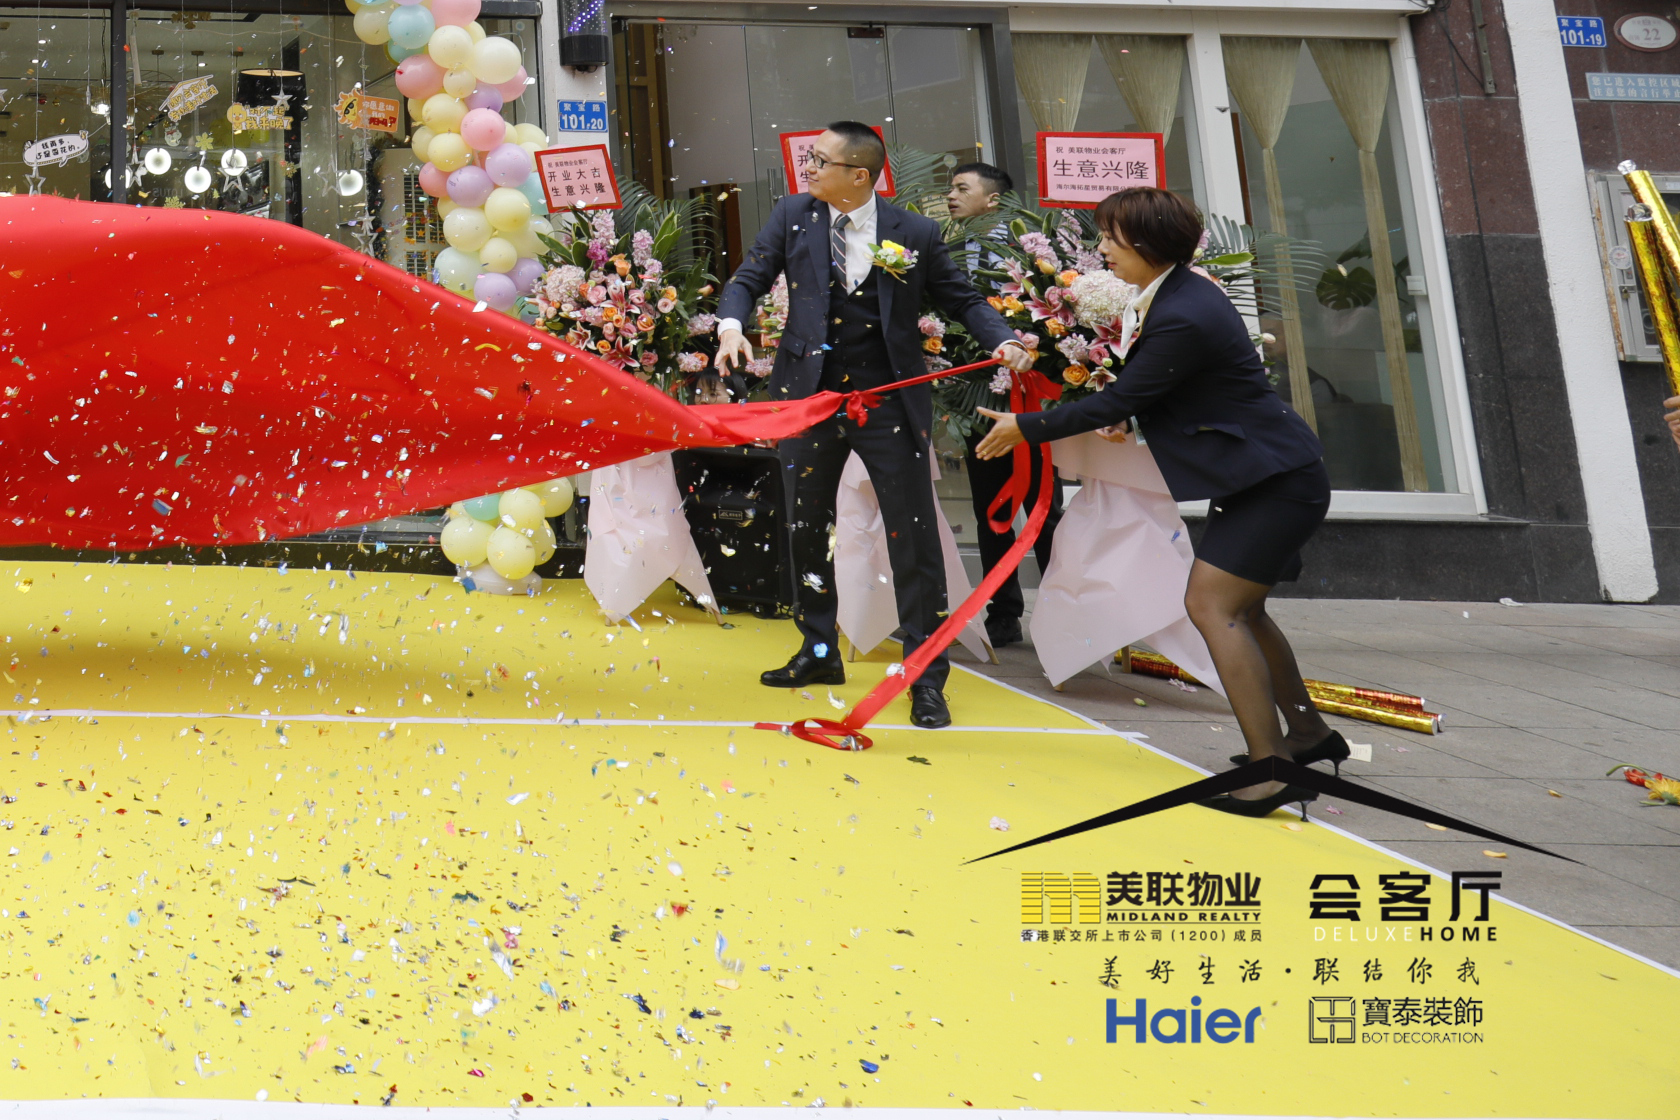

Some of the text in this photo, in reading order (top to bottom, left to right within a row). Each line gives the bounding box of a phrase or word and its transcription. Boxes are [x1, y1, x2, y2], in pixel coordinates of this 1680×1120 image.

[1560, 19, 1598, 28] 聚宝路
[1560, 29, 1603, 45] 101-19
[1642, 28, 1661, 41] 22
[563, 103, 601, 112] 聚宝路
[1056, 146, 1126, 155] 祝 美联物业会客厅
[548, 167, 601, 182] 开业大吉
[1053, 159, 1149, 179] 生意兴隆
[551, 182, 606, 197] 生意兴隆
